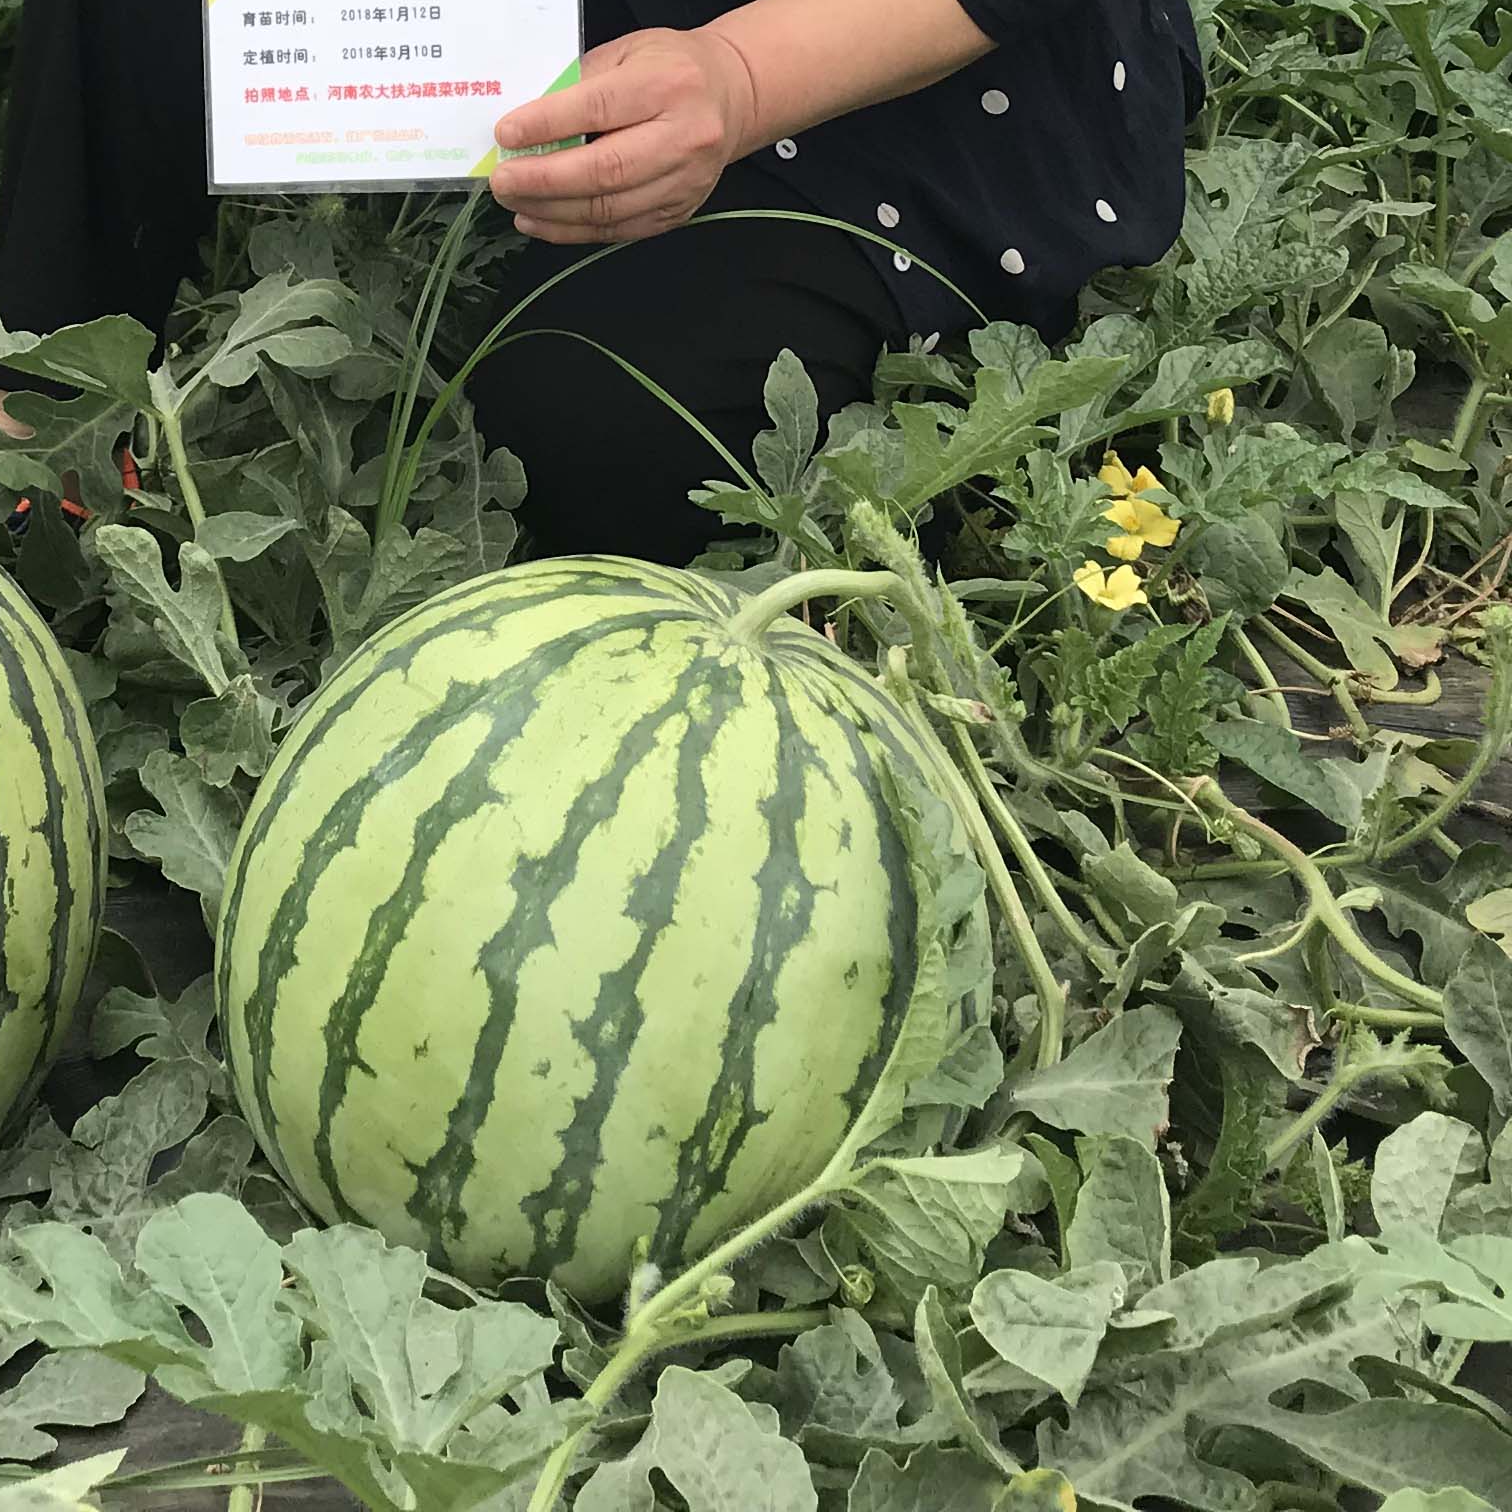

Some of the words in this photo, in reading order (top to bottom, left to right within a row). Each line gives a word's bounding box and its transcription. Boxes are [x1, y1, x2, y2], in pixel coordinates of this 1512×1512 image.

[341, 6, 442, 23] 2018年1月12日
[342, 44, 443, 61] 2018年3月10日
